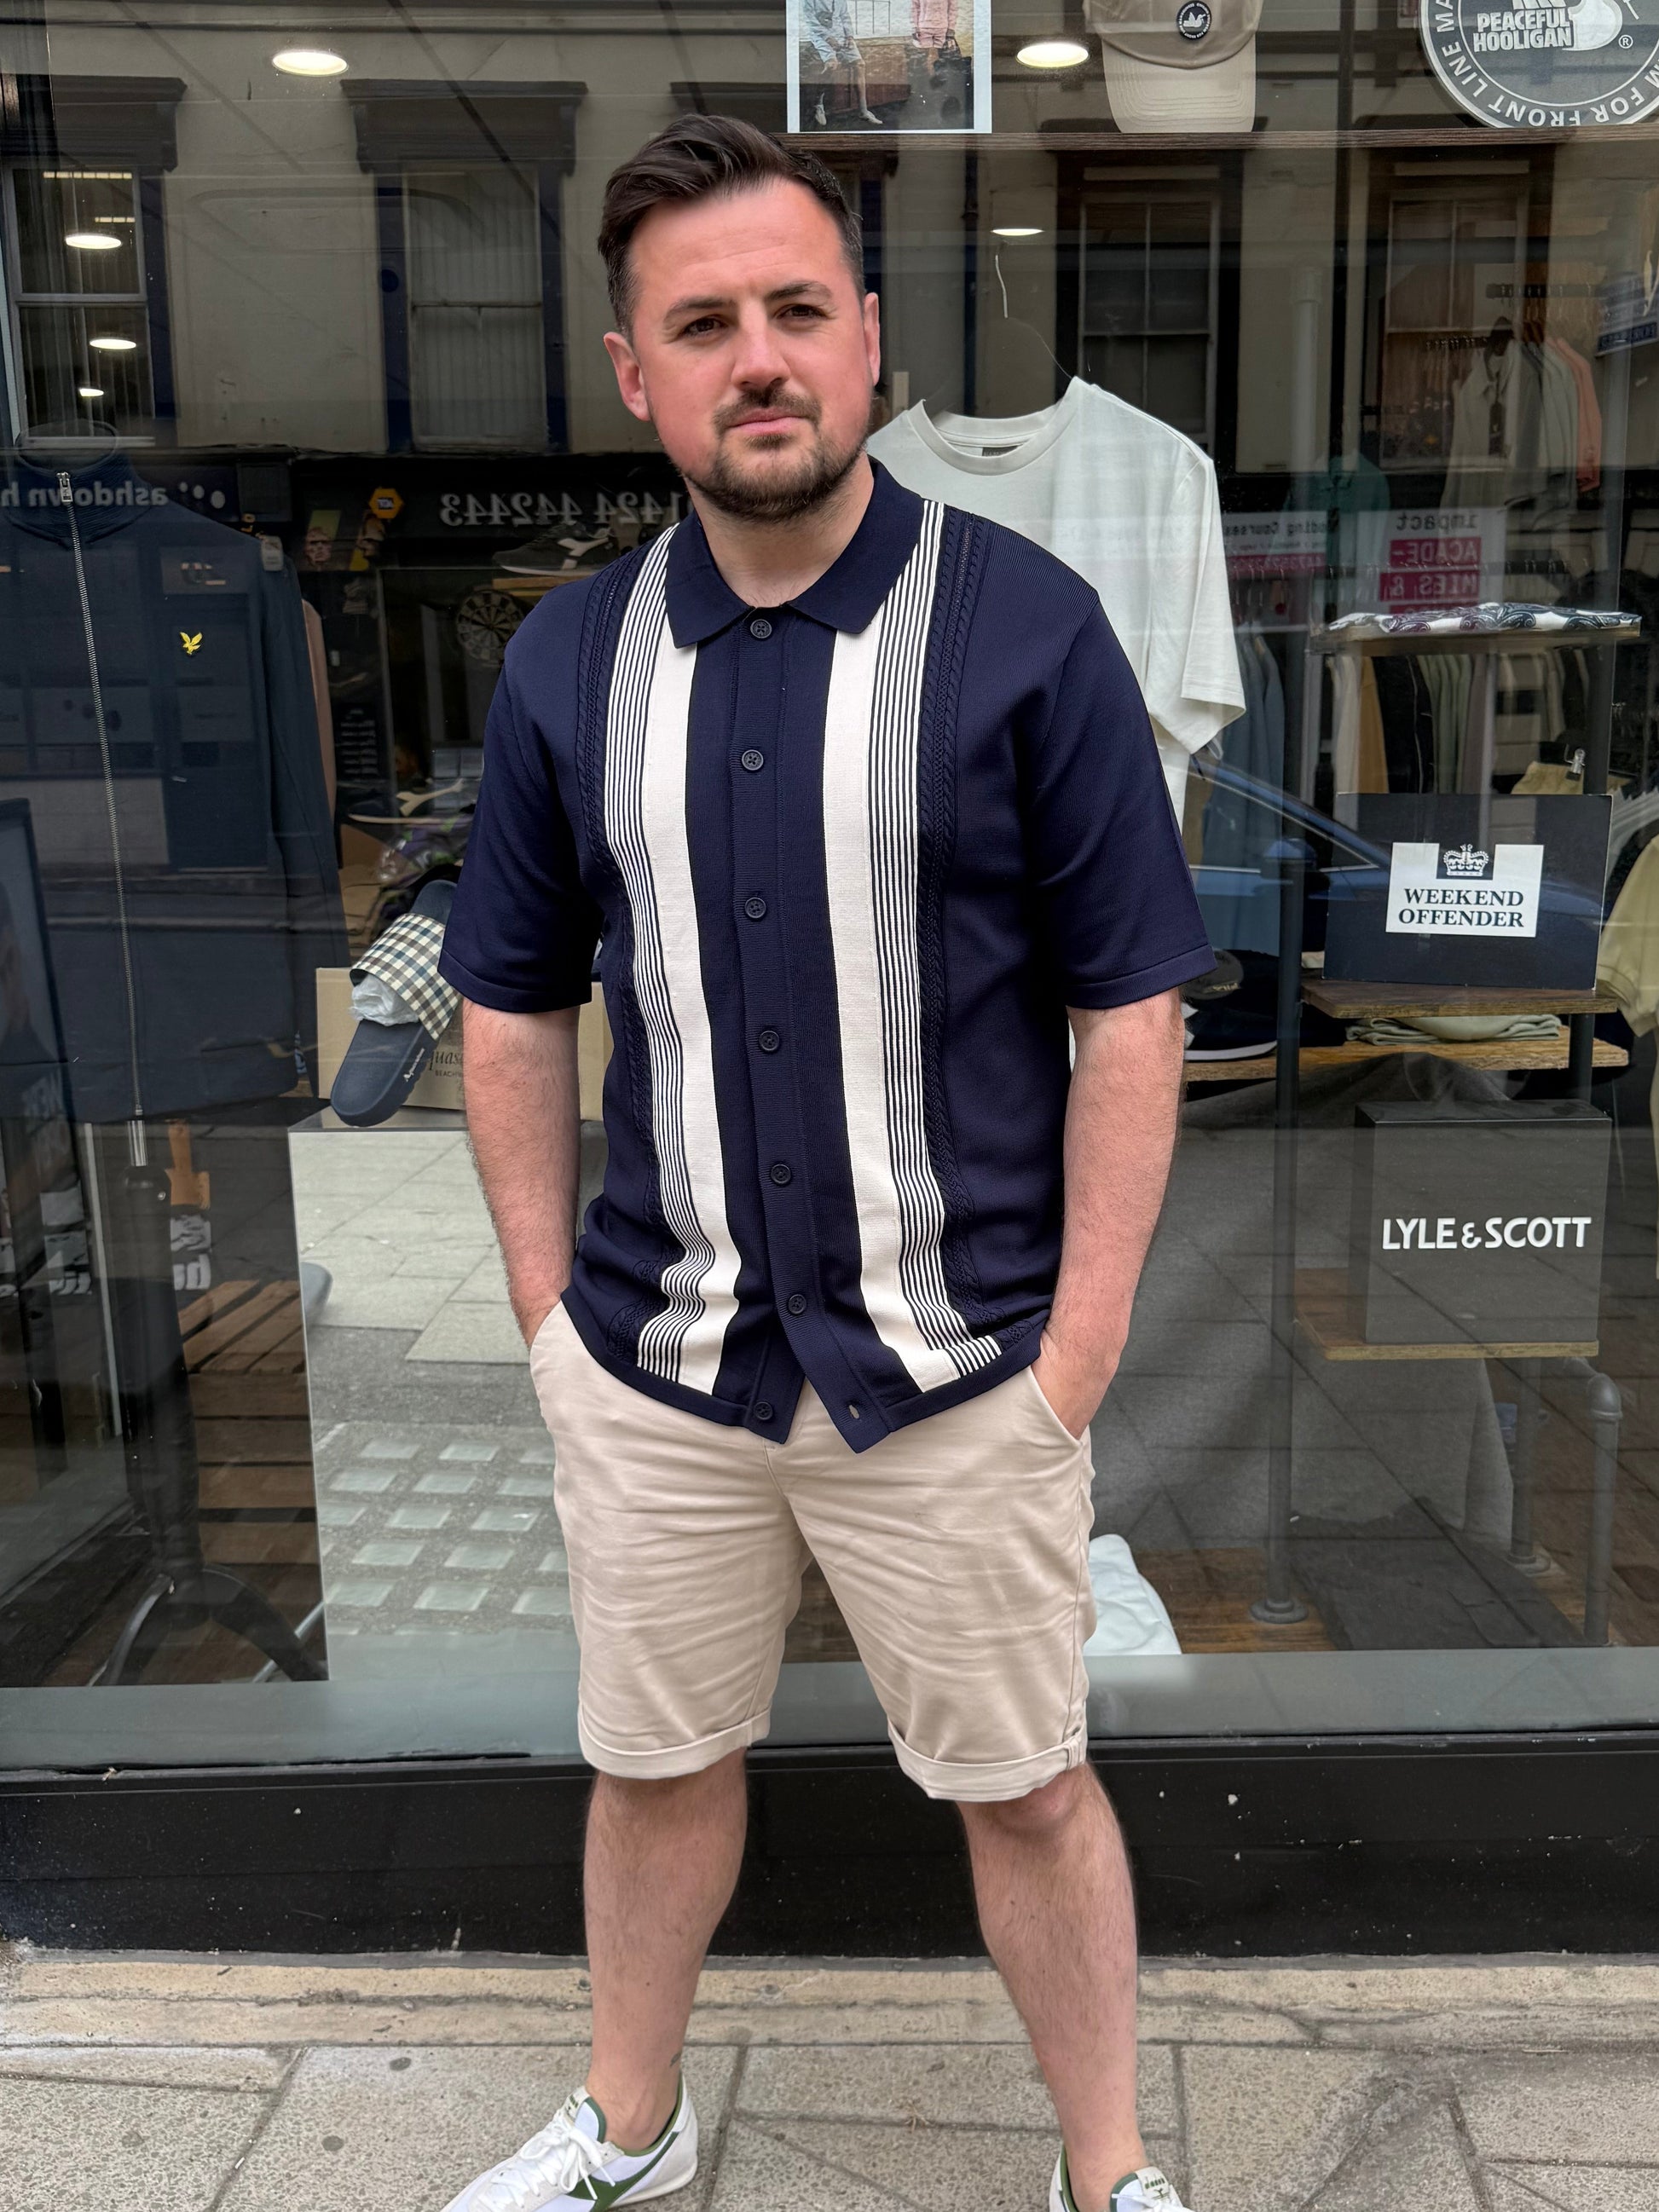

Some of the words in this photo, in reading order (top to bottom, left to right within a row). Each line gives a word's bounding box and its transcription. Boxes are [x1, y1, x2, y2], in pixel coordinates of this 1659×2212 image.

[1477, 8, 1570, 32] PEACEFUL
[1473, 27, 1573, 52] HOOLIGAN
[1441, 42, 1488, 97] LINE
[1488, 94, 1581, 127] FRONT
[1590, 86, 1645, 123] FOR
[1404, 888, 1524, 906] WEEKEND
[1398, 908, 1524, 927] OFFENDER
